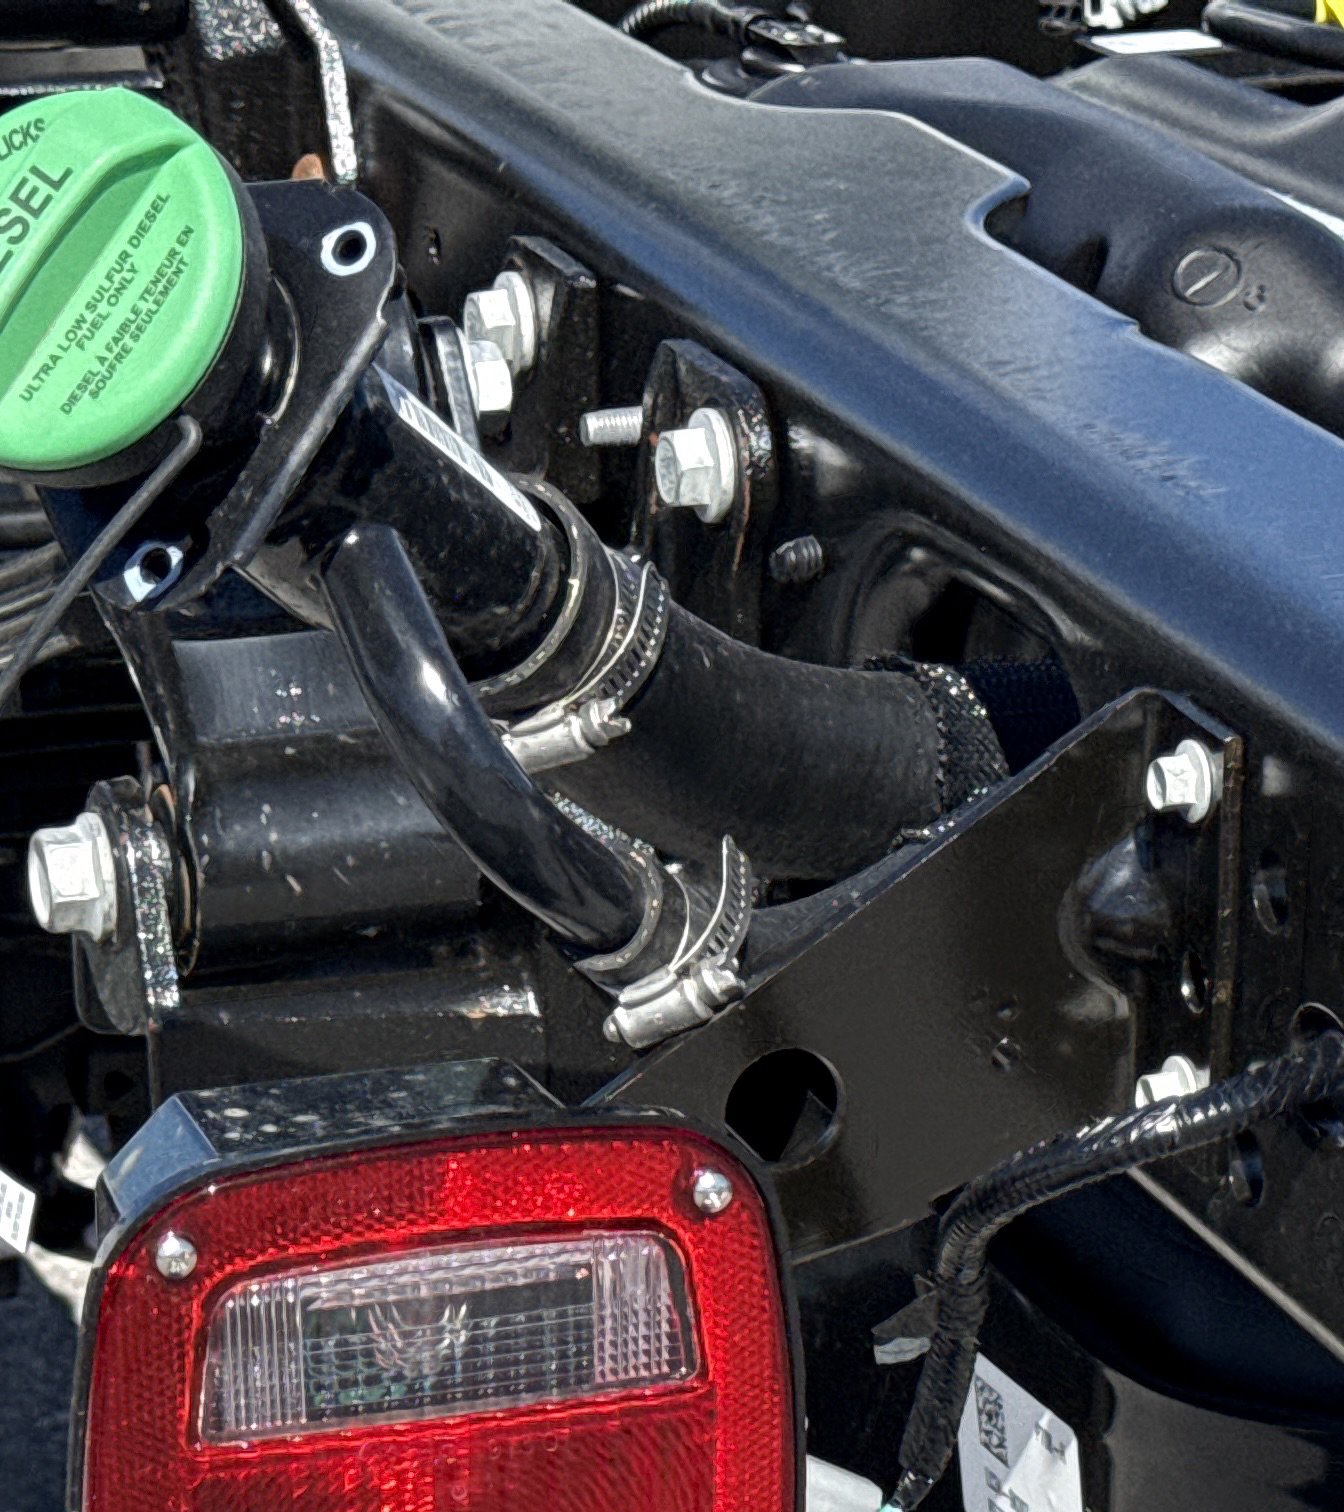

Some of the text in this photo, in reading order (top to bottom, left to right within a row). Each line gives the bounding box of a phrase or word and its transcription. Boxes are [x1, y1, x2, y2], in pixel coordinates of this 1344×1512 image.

[18, 194, 171, 402] ULTRA LOW SULFUR DIESEL
[59, 369, 101, 416] DIESEL
[104, 303, 144, 354] FAIBLE
[137, 247, 182, 304] TENEUR
[176, 224, 195, 248] EN
[75, 261, 139, 351] FUEL ONLY
[88, 254, 189, 400] SOUFRE SEULEMENT
